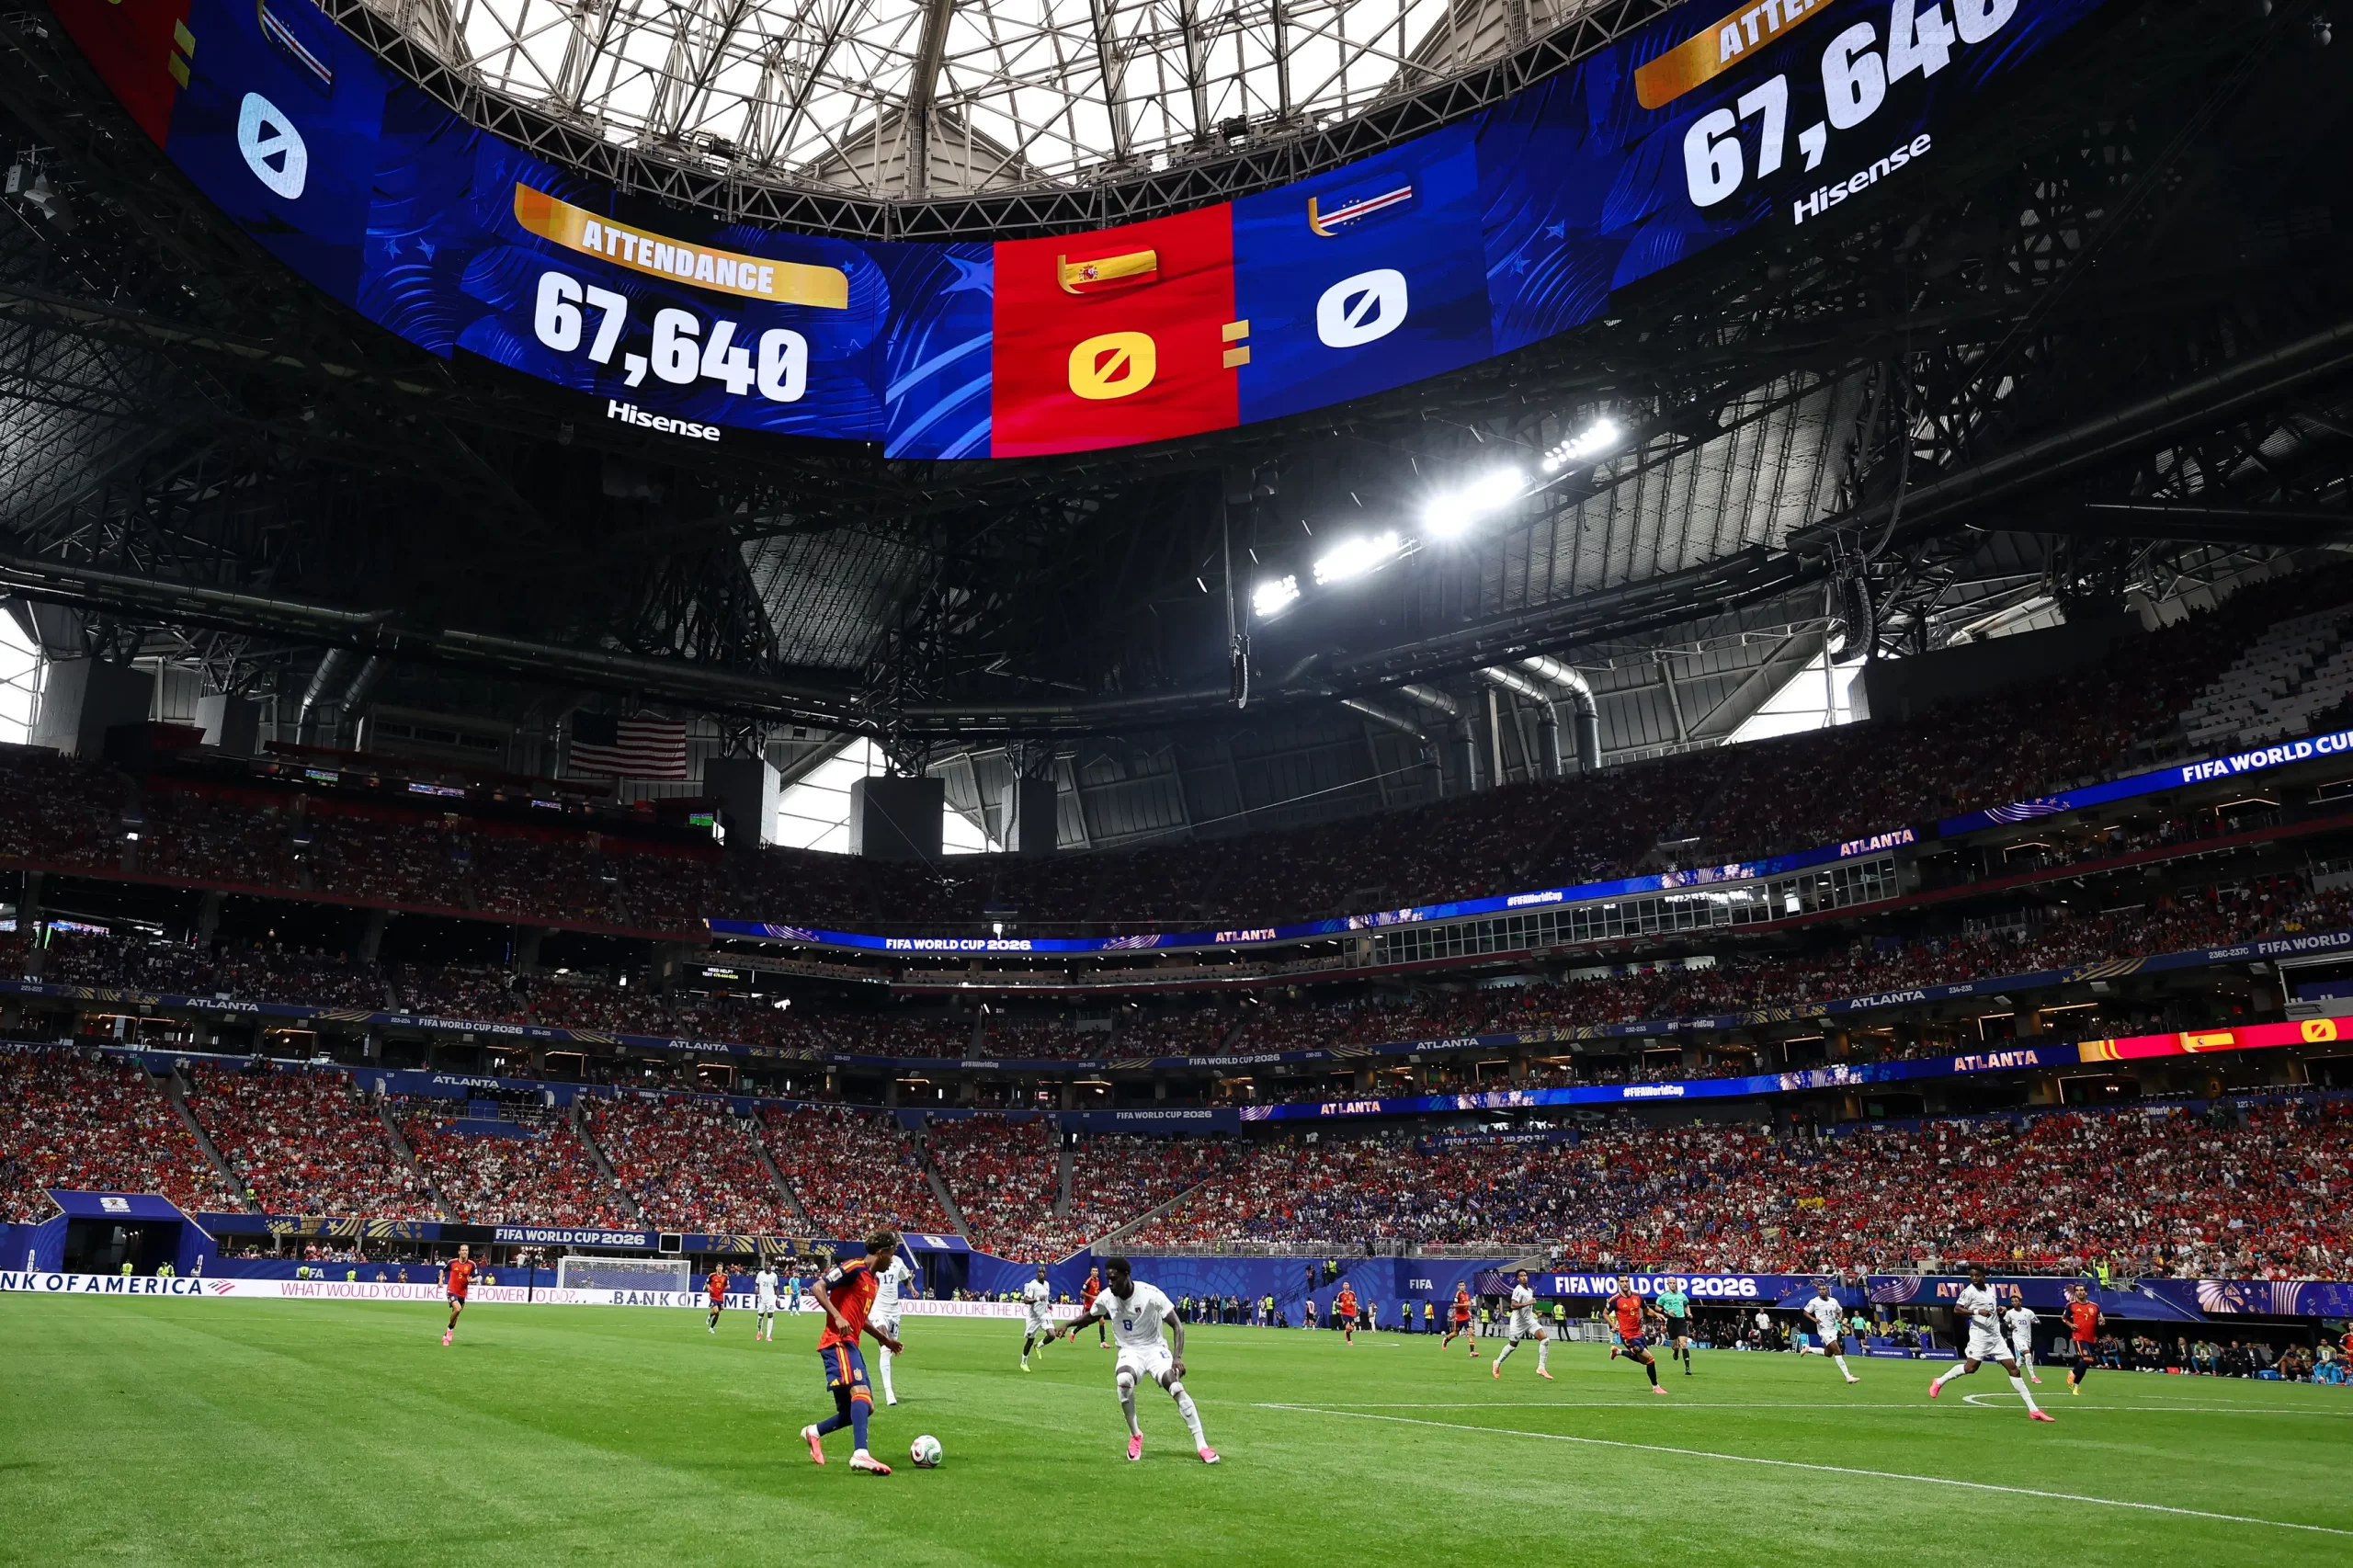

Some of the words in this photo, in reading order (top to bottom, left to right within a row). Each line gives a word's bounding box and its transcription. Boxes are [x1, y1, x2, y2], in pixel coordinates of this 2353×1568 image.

[237, 90, 308, 199] 0
[1793, 133, 1931, 226] Hisense
[582, 220, 774, 294] ATTENDANCE
[1316, 268, 1408, 348] 0
[534, 270, 808, 403] 67,640
[1068, 331, 1156, 400] 0
[607, 399, 721, 441] Hisense
[2182, 759, 2230, 782] FIFA
[2228, 742, 2313, 772] WORLD
[1840, 829, 1915, 857] ATLANTA
[1507, 892, 1563, 906] #FIFAWorldCup
[1215, 928, 1277, 942] ATLANTA
[885, 938, 912, 949] FIFA
[913, 938, 960, 950] WORLD
[961, 938, 985, 950] CUP
[987, 939, 1029, 950] 2026
[2208, 947, 2249, 960] 236C-237C
[2257, 940, 2292, 954] FIFA
[2291, 933, 2351, 950] WORLD
[1949, 985, 1972, 994] 234-235
[186, 998, 259, 1011] ATLANTA
[1849, 990, 1926, 1008] ATLANTA
[418, 1018, 438, 1027] FIFA
[439, 1020, 472, 1029] WORLD
[473, 1023, 491, 1031] CUP
[492, 1025, 524, 1034] 2026
[1667, 1019, 1715, 1030] #FIrldCup
[2300, 1018, 2337, 1043] 0
[668, 1040, 729, 1052] ATLANTA
[1415, 1038, 1479, 1051] ATLANTA
[1208, 1056, 1238, 1065] WORLD
[1239, 1056, 1254, 1064] CUP
[1255, 1054, 1280, 1062] 2026
[1954, 1050, 2039, 1072] ATLANTA
[432, 1075, 500, 1088] ATLANTA
[1622, 1085, 1684, 1097] #FIFAWorldCup
[1135, 1111, 1165, 1119] WORLD
[1165, 1110, 1182, 1119] CUP
[1183, 1110, 1212, 1119] 2026
[495, 1228, 523, 1241] FIFA
[525, 1229, 573, 1243] WORLD
[574, 1232, 600, 1244] CUP
[601, 1233, 645, 1245] 2026
[296, 1267, 324, 1278] FFA
[883, 1274, 894, 1285] 17
[46, 1275, 80, 1291] OF
[85, 1276, 203, 1294] AMERICA
[281, 1282, 325, 1297] WHAT
[326, 1283, 380, 1299] WOULD
[382, 1284, 414, 1299] YOU
[415, 1285, 444, 1300] LIKE
[477, 1288, 525, 1301] POWER
[1409, 1278, 1433, 1290] FIFA
[1555, 1277, 1590, 1294] FIFA
[1590, 1277, 1651, 1294] WOLD
[1690, 1278, 1756, 1297] 2026
[1937, 1282, 2023, 1299] ATNTA
[614, 1291, 669, 1306] BANK
[939, 1303, 962, 1315] YOU
[965, 1303, 987, 1315] LIKE
[990, 1304, 1012, 1316] THE
[1056, 1306, 1071, 1317] TO
[1630, 1308, 1635, 1316] 6
[889, 1323, 899, 1335] 17
[1122, 1319, 1133, 1332] 8
